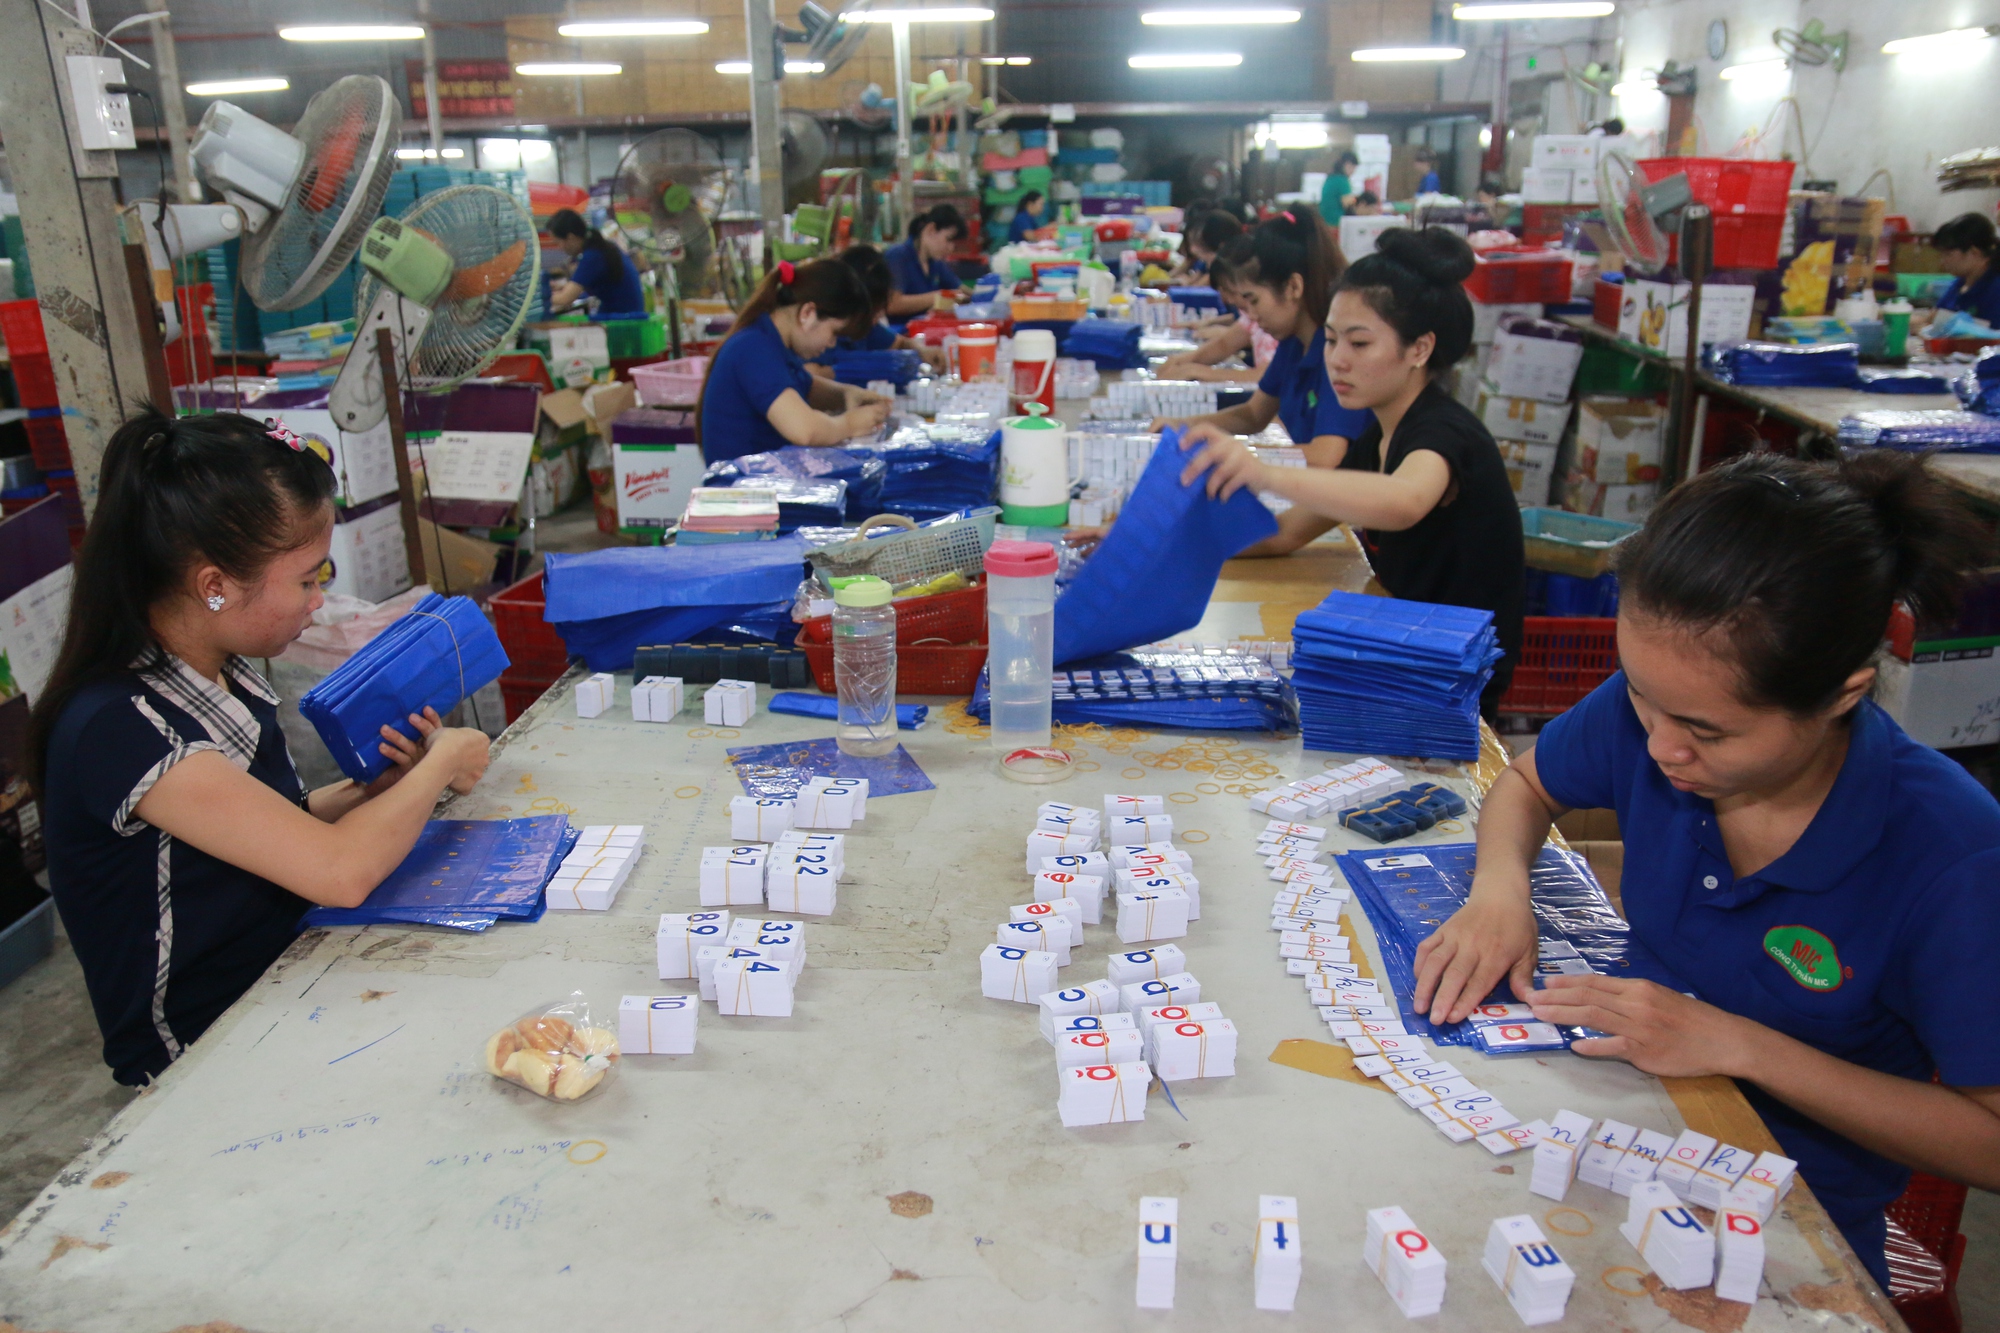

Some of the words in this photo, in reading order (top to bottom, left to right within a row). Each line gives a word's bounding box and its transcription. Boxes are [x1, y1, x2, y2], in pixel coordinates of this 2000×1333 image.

[833, 779, 861, 787] 0
[822, 788, 850, 796] 0
[756, 800, 783, 808] 5
[731, 847, 762, 856] 6
[727, 858, 757, 866] 7
[796, 855, 826, 865] 2
[798, 866, 829, 876] 2
[687, 913, 720, 922] 8
[686, 926, 719, 935] 9
[761, 922, 794, 933] 3
[757, 935, 791, 945] 3
[728, 947, 761, 958] 4
[1790, 939, 1823, 973] MIC
[746, 961, 781, 973] 4
[1814, 978, 1829, 987] MIC
[651, 996, 688, 1010] 10
[1550, 1126, 1577, 1144] n
[1710, 1148, 1740, 1174] h
[1751, 1168, 1778, 1184] a
